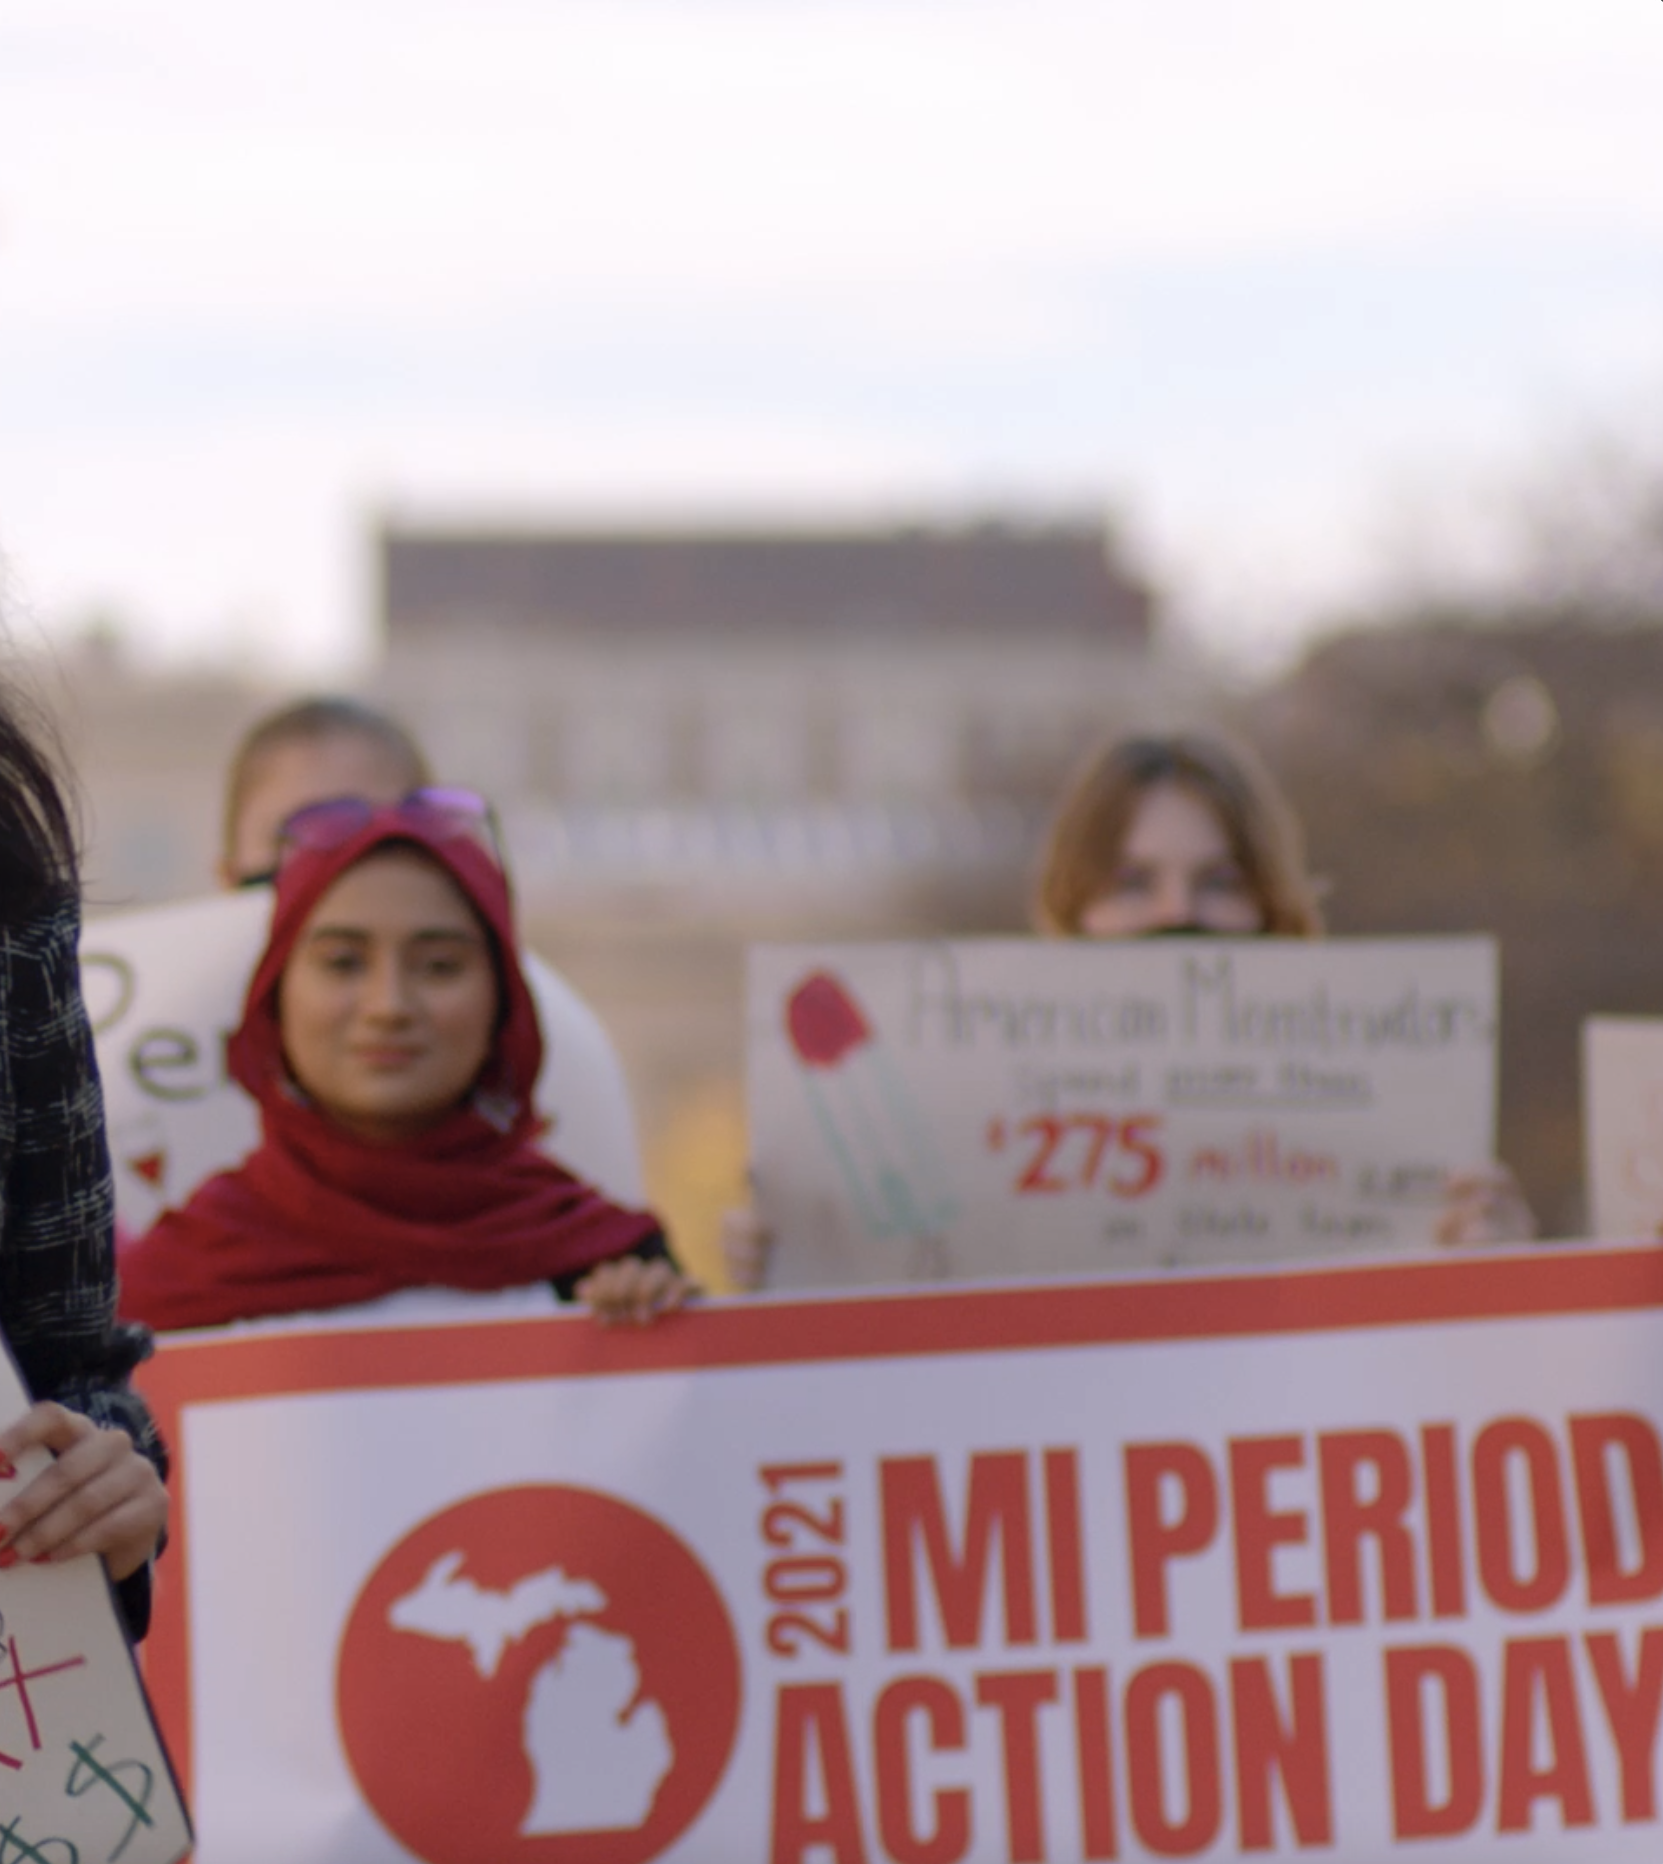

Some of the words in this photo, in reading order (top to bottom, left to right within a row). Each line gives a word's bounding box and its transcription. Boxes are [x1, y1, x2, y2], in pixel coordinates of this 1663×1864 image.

[757, 1461, 852, 1660] 2021
[877, 1446, 1089, 1655] MI
[1123, 1410, 1663, 1641] PERIOD
[769, 1652, 1336, 1864] ACTION
[1382, 1624, 1663, 1843] DAY
